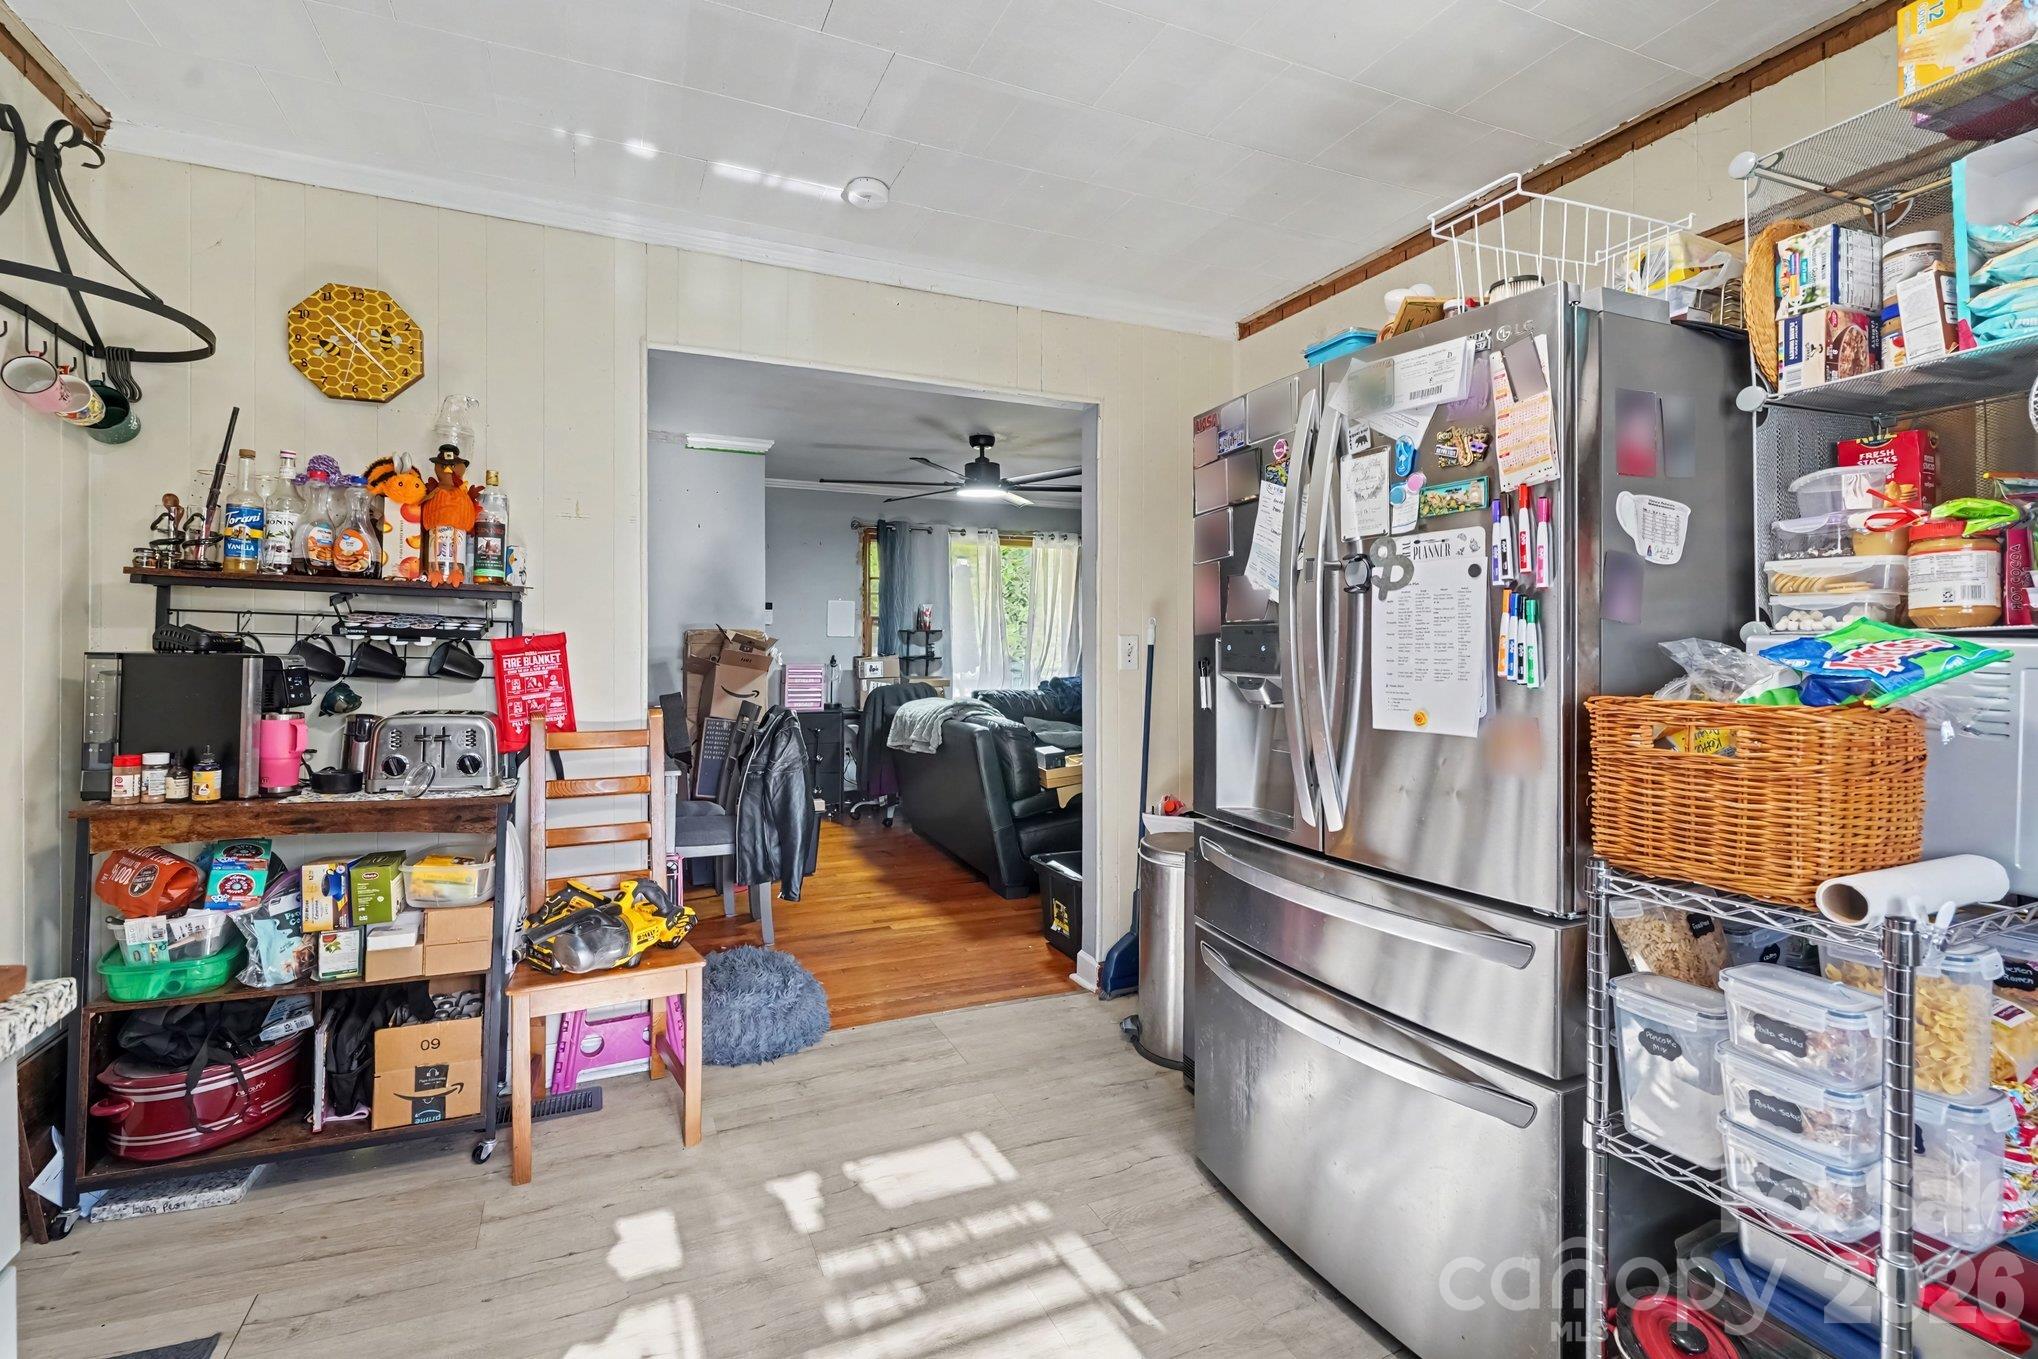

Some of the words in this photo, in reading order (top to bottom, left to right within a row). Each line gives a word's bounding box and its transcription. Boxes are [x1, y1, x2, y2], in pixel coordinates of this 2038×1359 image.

[322, 291, 332, 301] 11
[351, 292, 365, 302] 12
[385, 303, 391, 312] 1
[298, 309, 310, 319] 10
[404, 322, 411, 332] 2
[294, 333, 302, 343] 9
[408, 345, 415, 355] 3
[300, 357, 308, 367] 8
[401, 368, 409, 377] 4
[320, 375, 328, 385] 7
[351, 384, 359, 393] 6
[380, 384, 388, 393] 5
[1860, 449, 1894, 461] FRESH
[1857, 455, 1898, 466] STACKS
[223, 509, 262, 529] Torani
[227, 542, 255, 552] VANILLA
[1413, 543, 1451, 560] PLANNER
[2009, 543, 2022, 584] COCOA
[2010, 586, 2023, 610] HOT
[502, 656, 522, 670] FIRE
[523, 652, 562, 668] BLANKET
[420, 1037, 441, 1051] 09
[414, 1113, 442, 1125] prime
